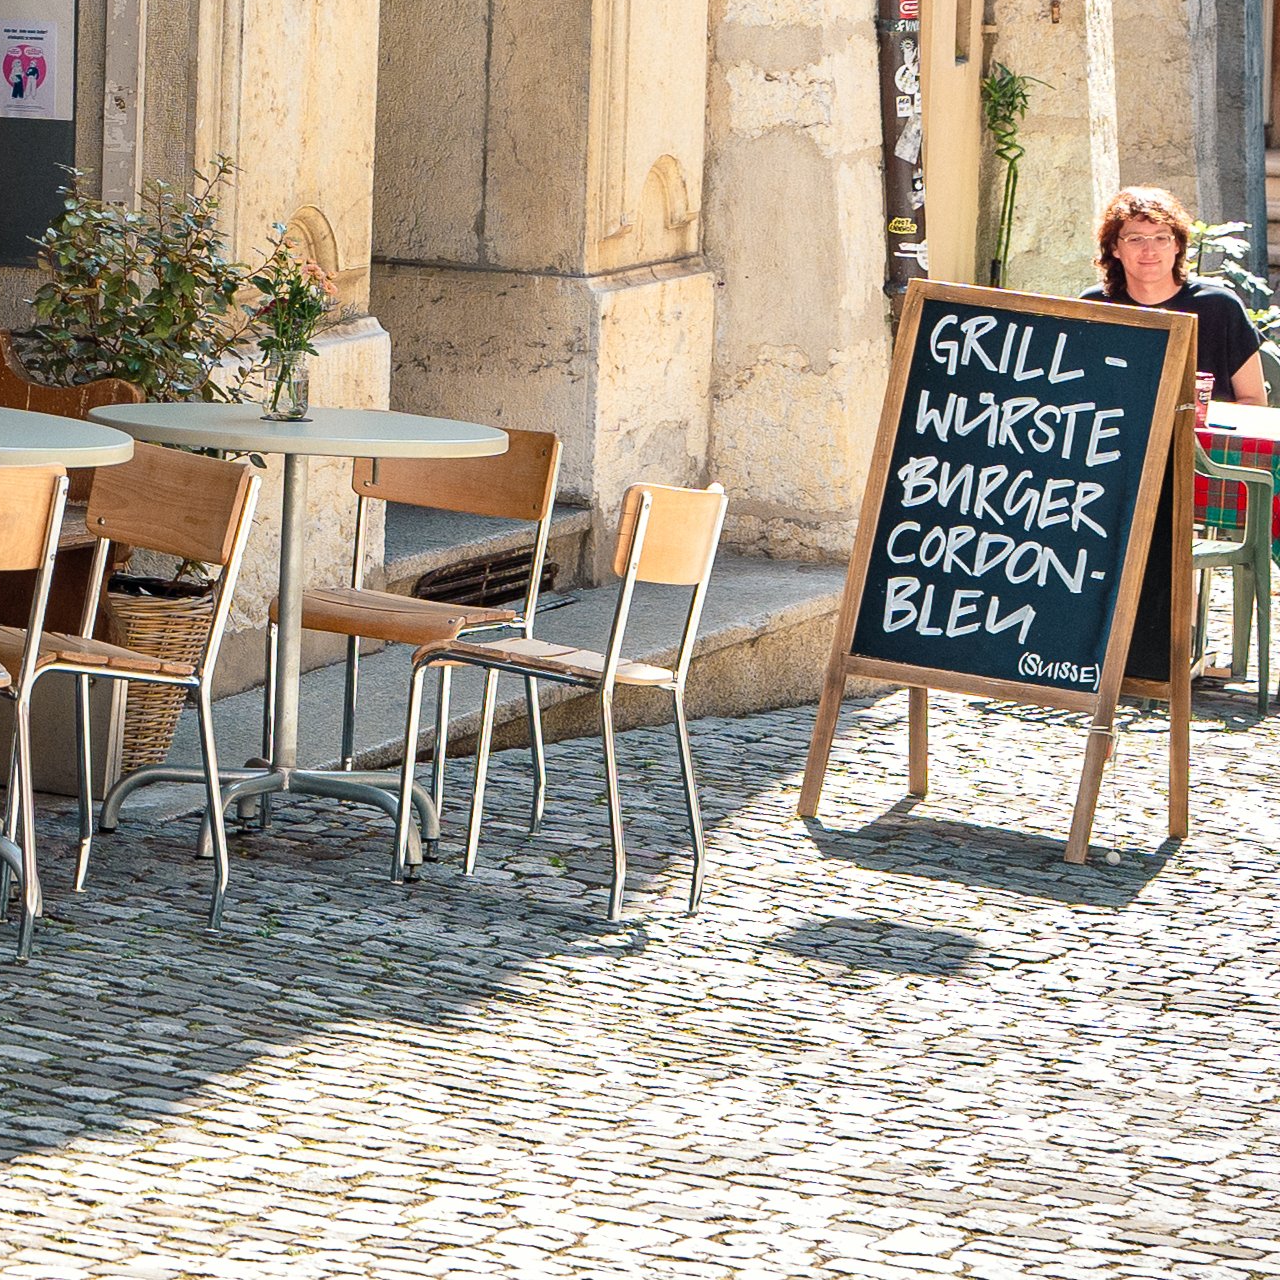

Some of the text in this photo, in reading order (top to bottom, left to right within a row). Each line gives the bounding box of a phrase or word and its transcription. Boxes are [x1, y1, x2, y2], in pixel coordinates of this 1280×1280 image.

[929, 314, 1084, 385] GRILL
[915, 389, 1124, 467] WÜRSTE
[898, 455, 1107, 538] BURGER
[886, 521, 1105, 595] CORDON-
[882, 576, 1036, 645] BLEU
